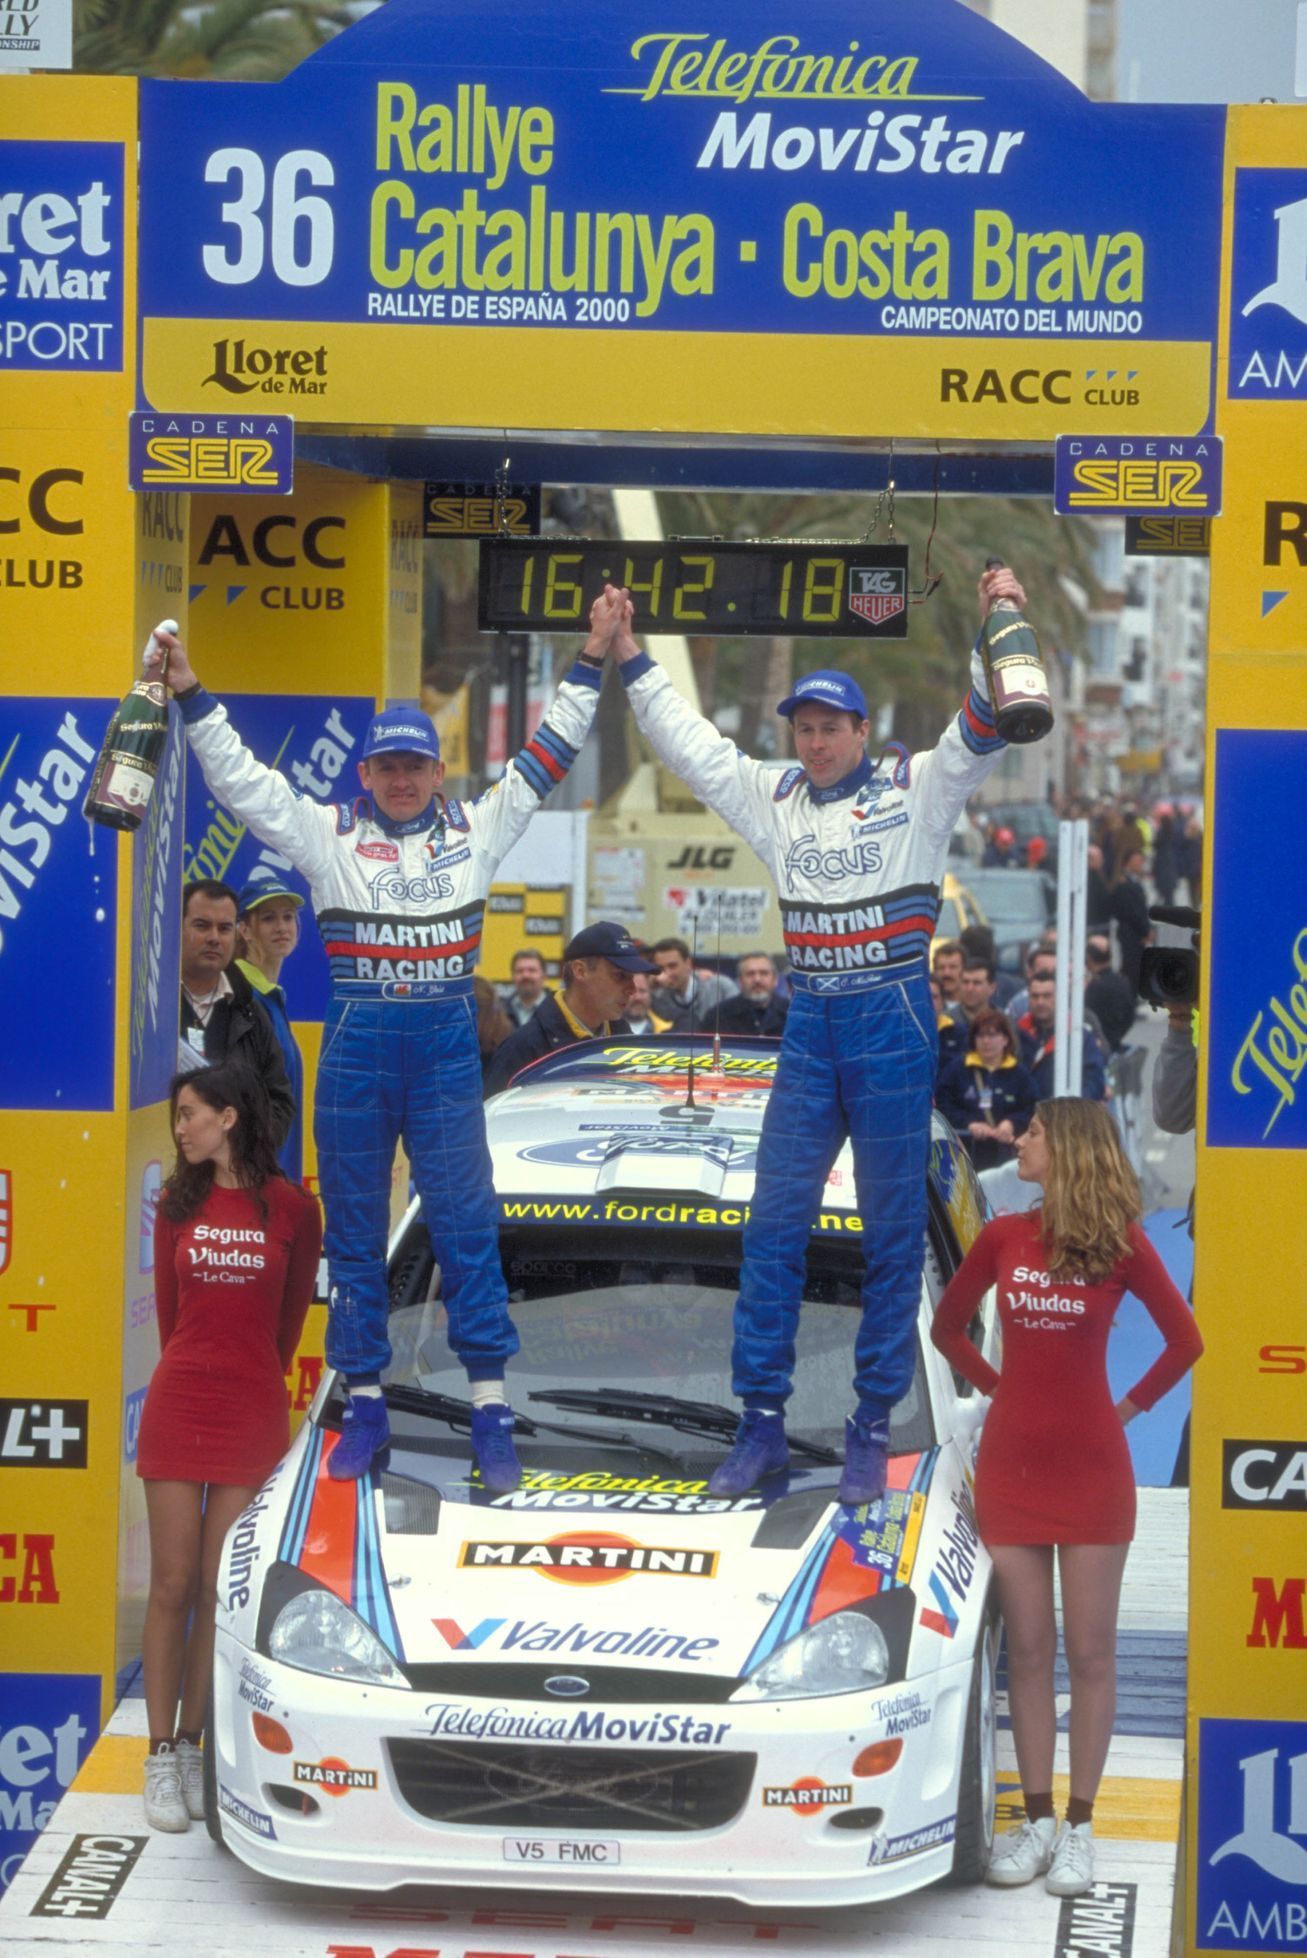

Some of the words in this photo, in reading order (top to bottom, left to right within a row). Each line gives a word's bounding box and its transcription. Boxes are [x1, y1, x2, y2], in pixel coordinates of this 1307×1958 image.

[375, 81, 554, 190] Rallye
[697, 110, 1024, 175] MoviStar
[202, 147, 335, 286] 36
[368, 180, 715, 317] Catalunya
[783, 202, 950, 300] Costa
[971, 209, 1145, 303] Brava
[17, 259, 110, 300] Mar
[367, 292, 445, 318] RALLYE
[451, 294, 479, 318] DE
[485, 291, 568, 320] ESPAÑA
[575, 297, 630, 322] 2000
[881, 306, 1019, 332] CAMPEONATO
[1023, 308, 1062, 332] DEL
[1066, 309, 1142, 333] MUNDO
[201, 338, 328, 394] Lloret
[260, 377, 284, 395] de
[288, 378, 328, 395] Mar
[941, 369, 1072, 404] RACC
[1084, 388, 1140, 407] CLUB
[142, 419, 279, 435] CADENA
[142, 436, 279, 485] SER
[1069, 442, 1209, 456] CADENA
[1068, 460, 1208, 507] SER
[197, 514, 346, 569] ACC
[0, 559, 84, 589] LUB
[858, 571, 897, 594] TAG
[260, 585, 345, 610] CLUB
[852, 596, 902, 620] HEUER
[666, 846, 737, 869] JLG
[355, 919, 464, 947] MARTINI
[787, 905, 884, 934] MARTINI
[355, 955, 464, 980] RACING
[790, 941, 888, 969] RACING
[193, 1225, 265, 1244] Segura
[188, 1247, 265, 1269] Viudas
[1012, 1266, 1086, 1288] Sega
[1006, 1291, 1085, 1315] Viudas
[489, 1490, 763, 1512] MoviStar
[473, 1545, 705, 1573] MARTINI
[500, 1620, 720, 1660] Valvoline
[568, 1711, 732, 1745] MoviStar
[297, 1764, 375, 1787] MARTINI
[766, 1785, 852, 1807] MARTINI
[515, 1841, 544, 1860] V5
[558, 1843, 608, 1862] FMC
[887, 1818, 956, 1858] MICHELIN
[44, 1836, 136, 1917] CANAL+
